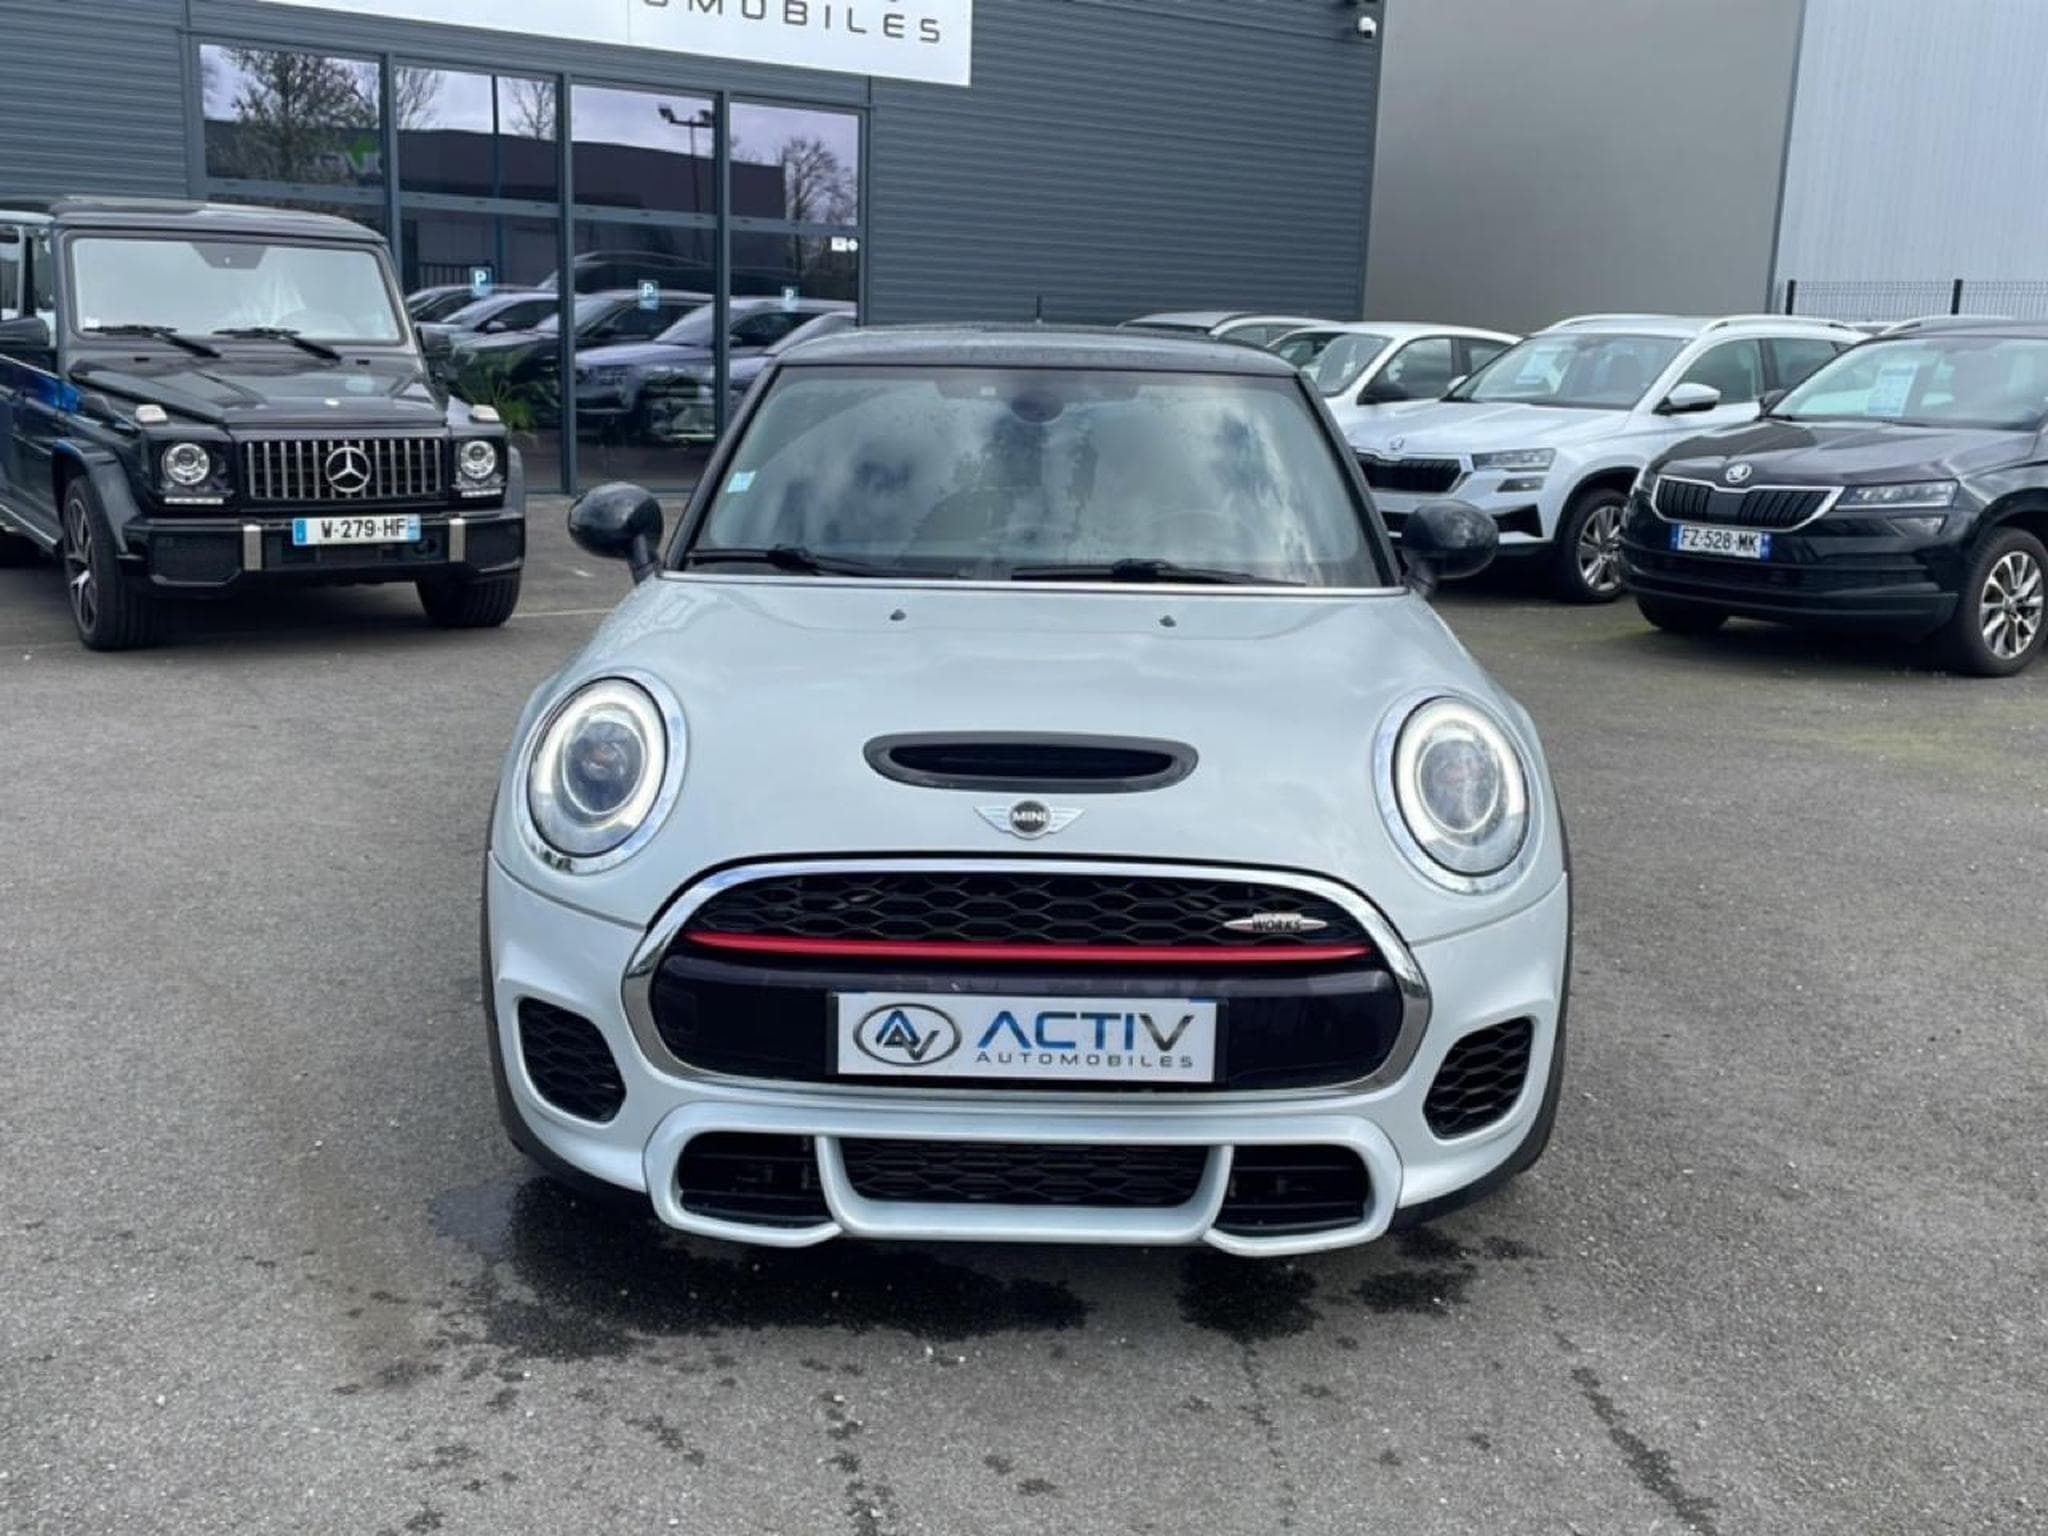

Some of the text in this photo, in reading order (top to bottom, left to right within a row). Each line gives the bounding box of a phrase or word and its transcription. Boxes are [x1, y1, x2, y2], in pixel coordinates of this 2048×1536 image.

[643, 0, 941, 43] MOBILES
[1012, 810, 1046, 822] MINI
[977, 1010, 1195, 1052] ACTIV
[975, 1051, 1194, 1068] AUTOMOBILES
